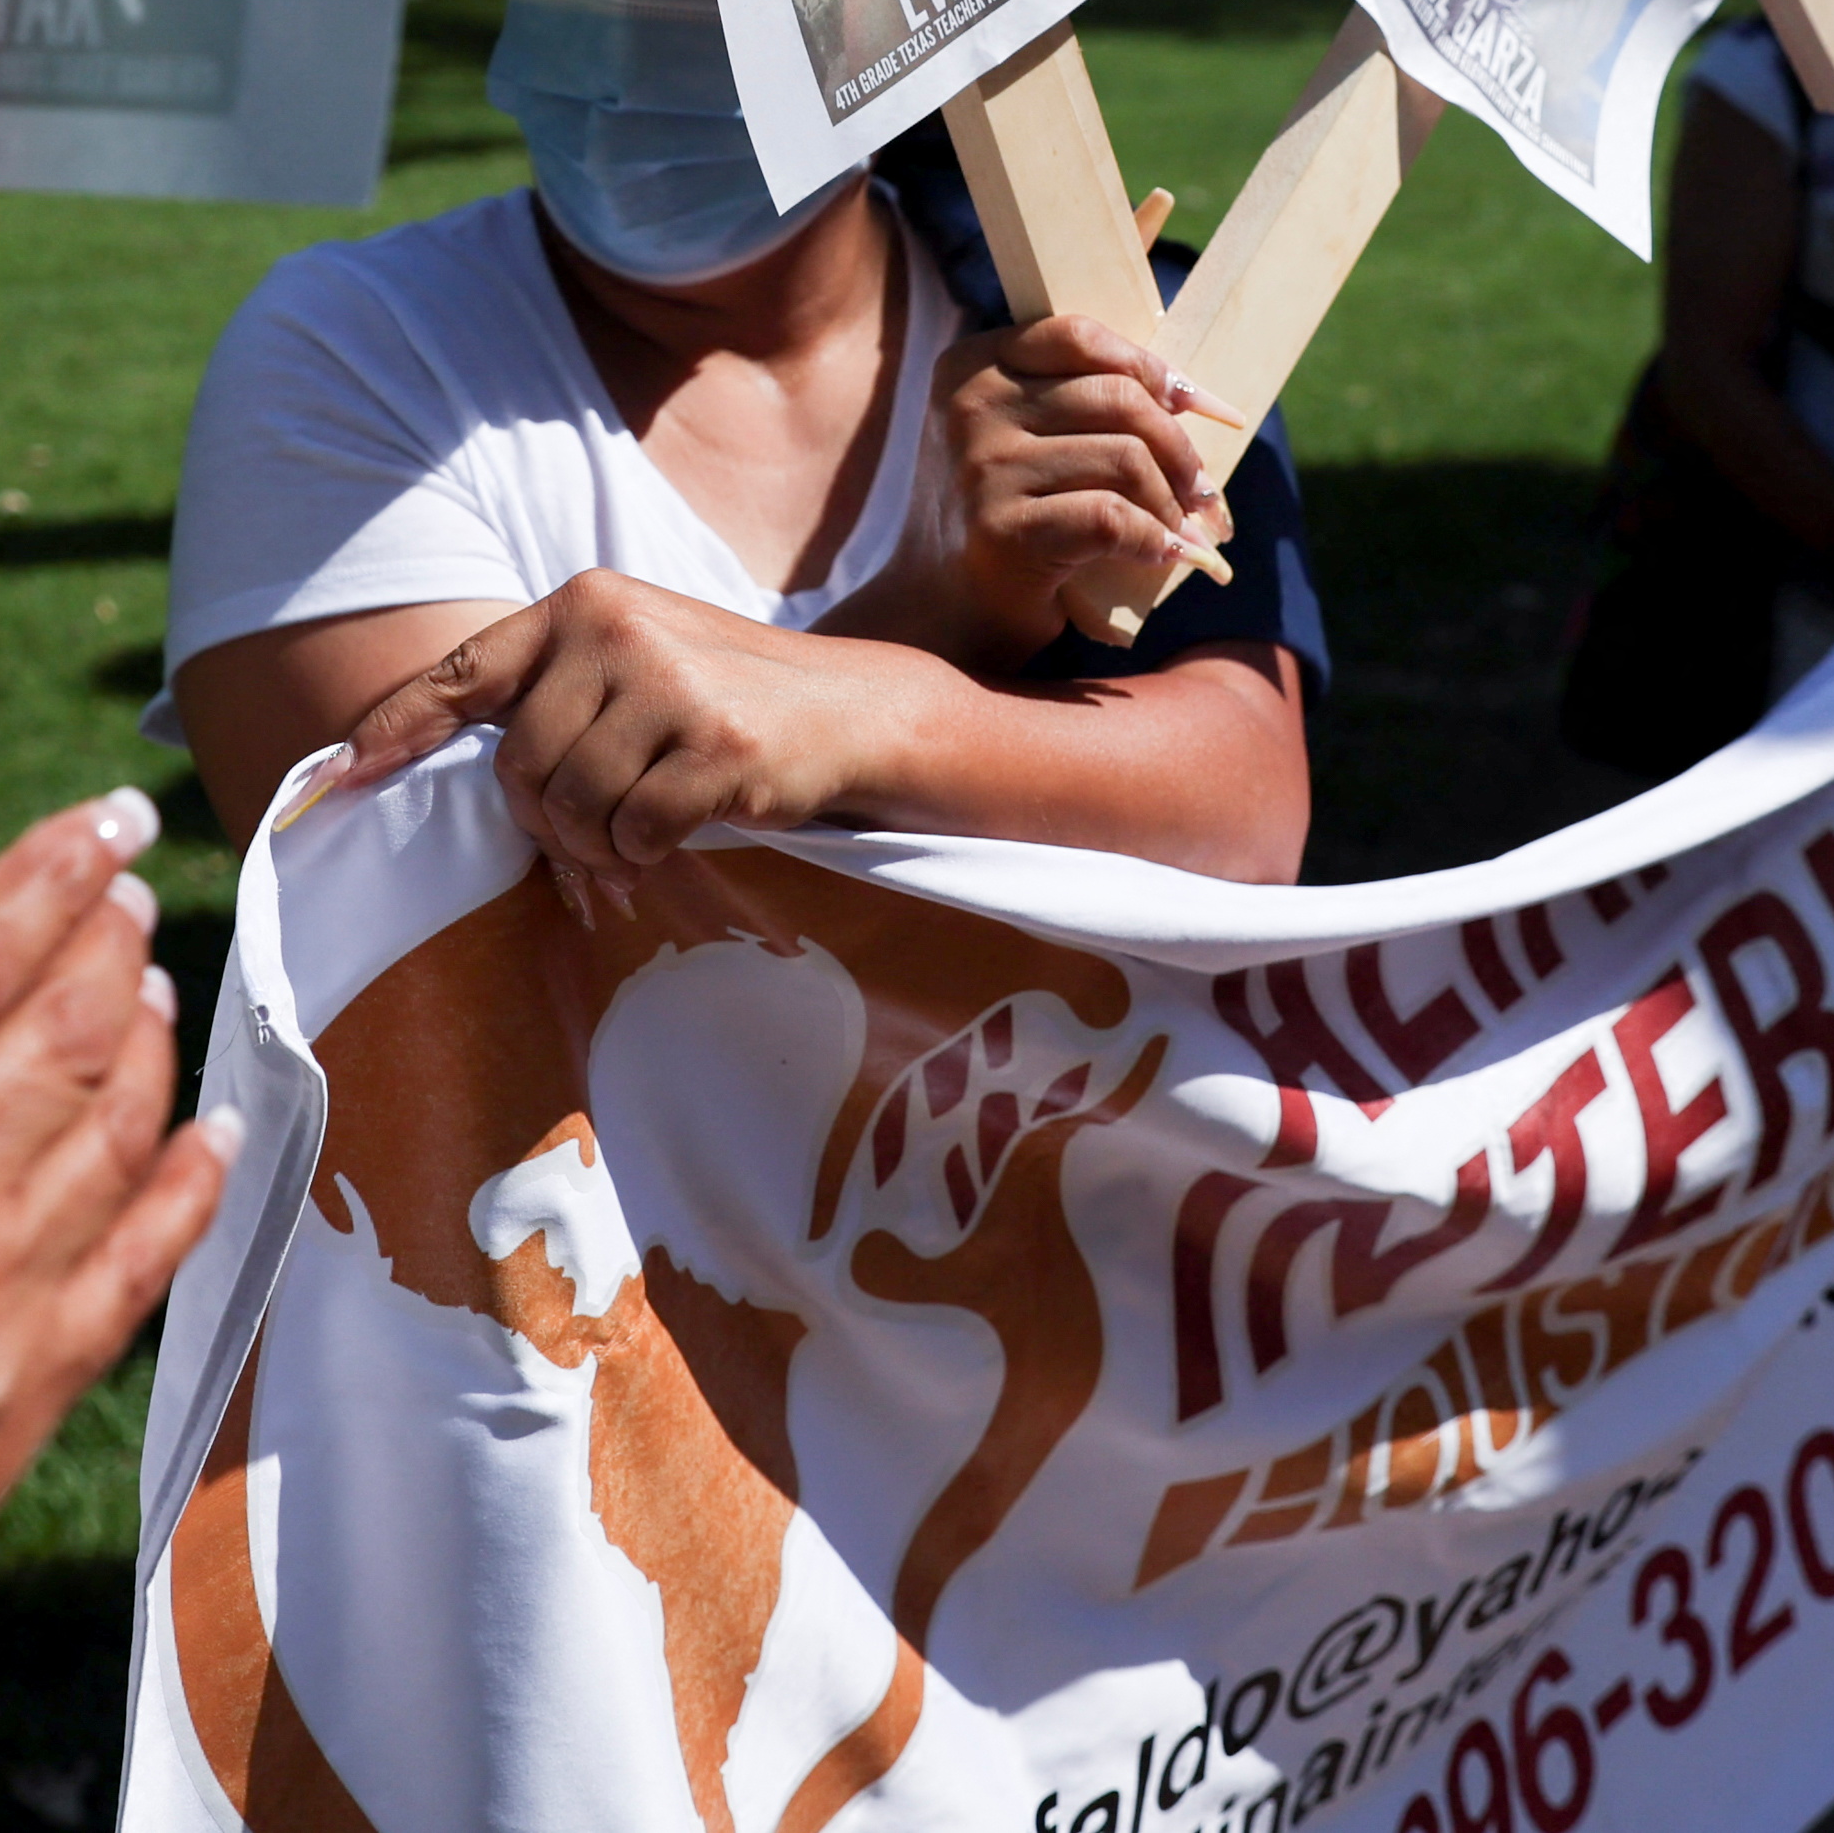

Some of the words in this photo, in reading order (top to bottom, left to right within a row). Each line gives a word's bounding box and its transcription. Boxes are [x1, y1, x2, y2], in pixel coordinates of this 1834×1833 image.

[835, 78, 861, 110] 4TH
[857, 52, 901, 94] GRADE
[896, 24, 936, 67] TEXAS
